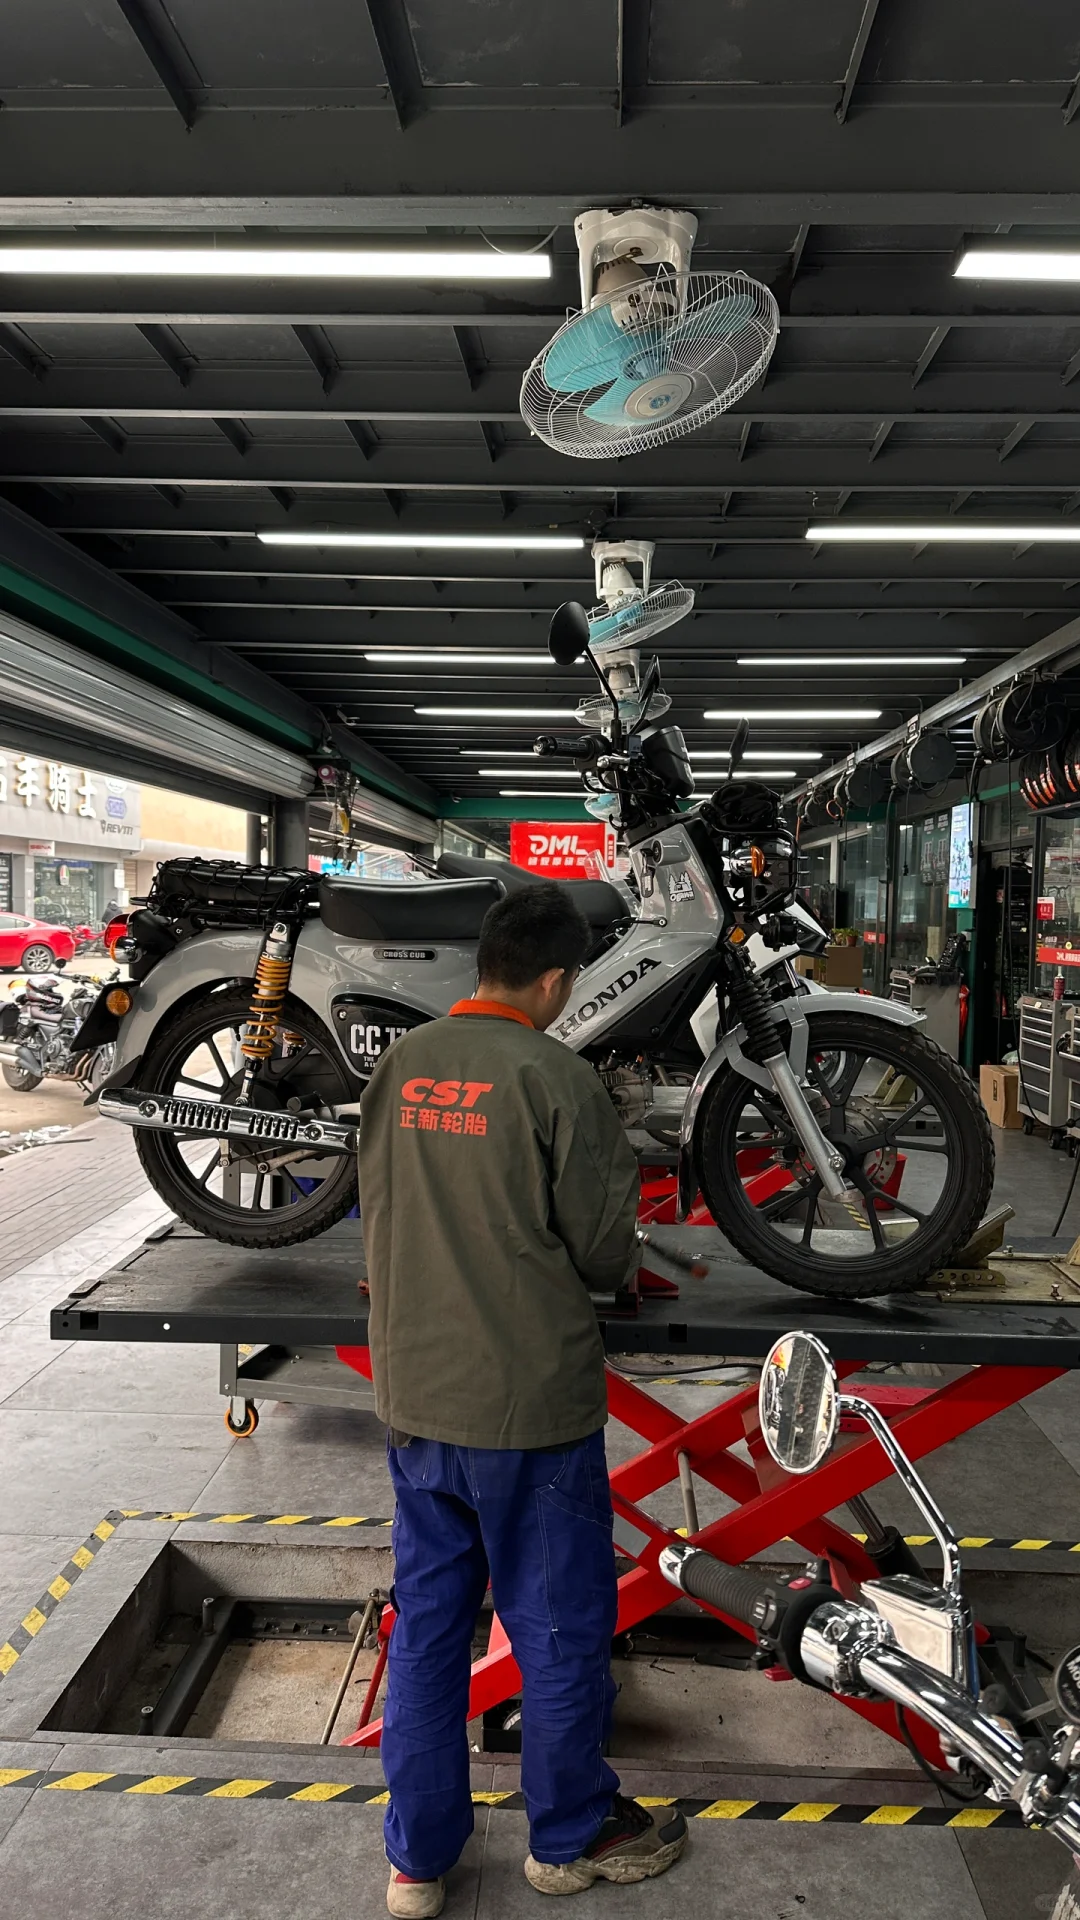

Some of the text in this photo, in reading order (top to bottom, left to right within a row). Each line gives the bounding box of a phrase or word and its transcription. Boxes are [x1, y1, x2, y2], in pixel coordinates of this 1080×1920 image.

[528, 834, 589, 855] DML
[383, 950, 426, 959] CROSS CUB
[555, 957, 662, 1040] HONDA
[350, 1023, 381, 1056] CC
[401, 1077, 494, 1108] CST
[400, 1106, 488, 1136] 正新轮胎
